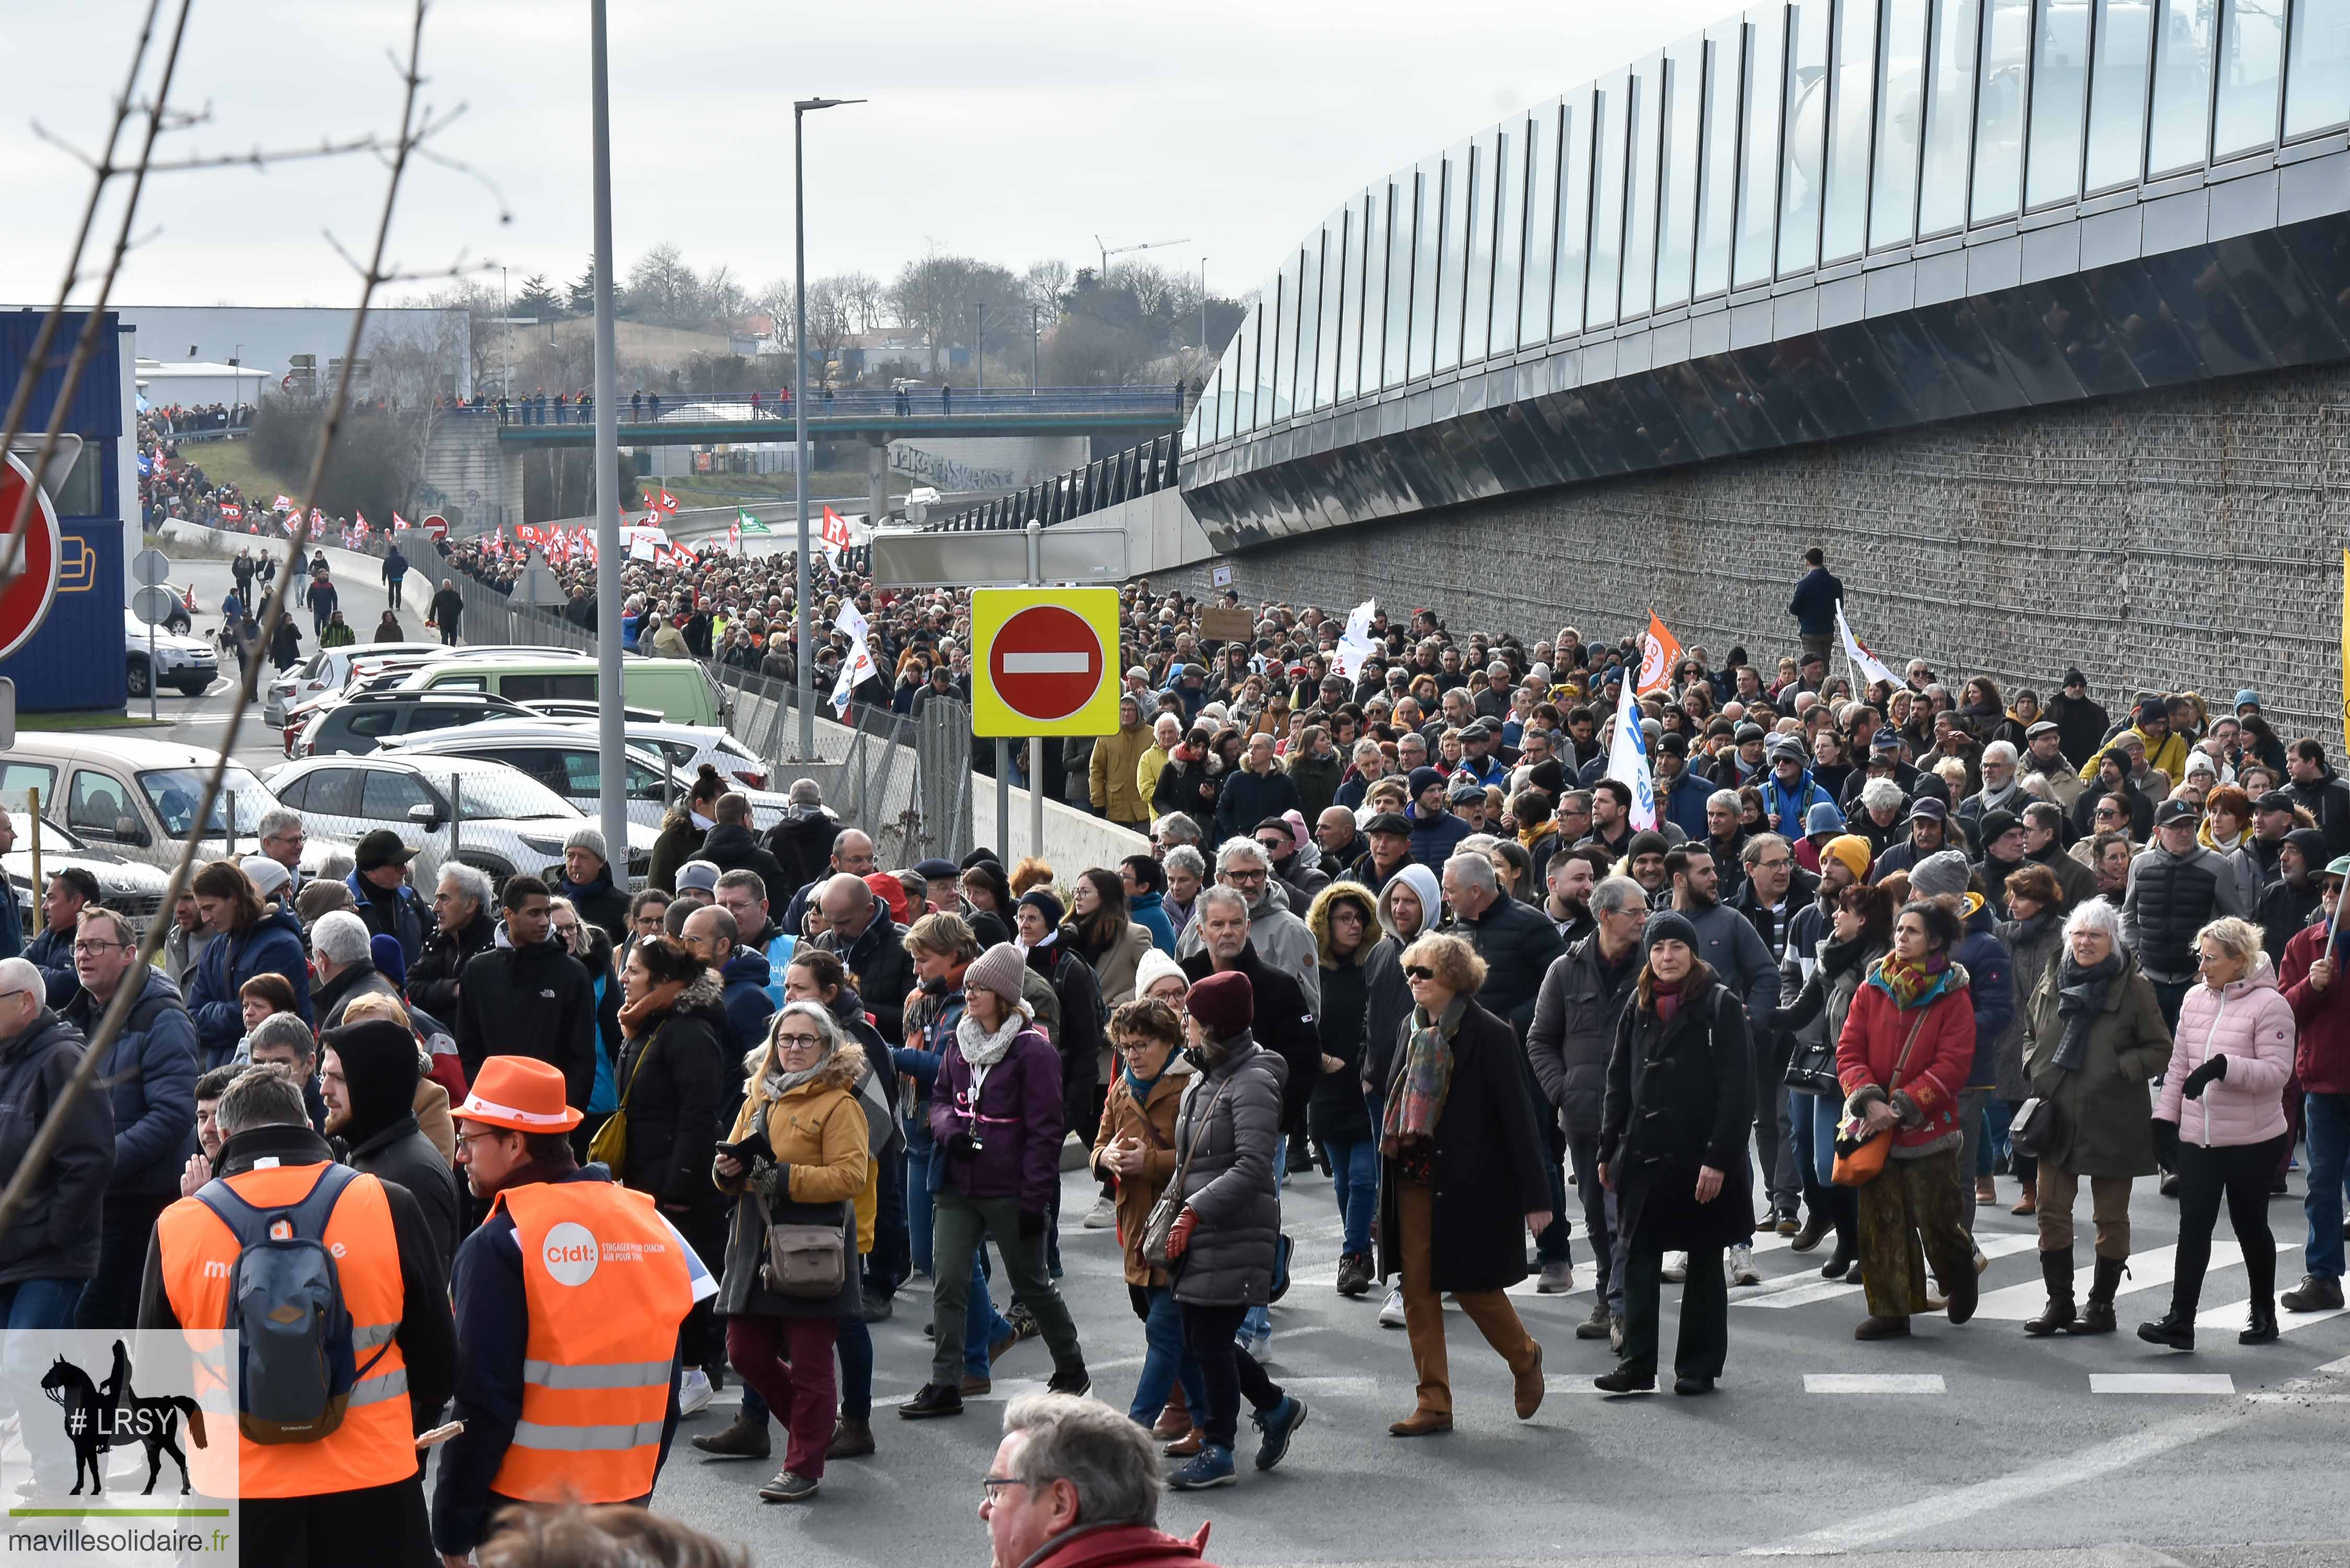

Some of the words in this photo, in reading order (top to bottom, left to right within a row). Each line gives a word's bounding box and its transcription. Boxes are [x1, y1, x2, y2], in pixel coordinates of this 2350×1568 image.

[222, 507, 239, 516] FO
[522, 526, 534, 537] FO
[673, 547, 694, 568] FO
[615, 1253, 631, 1262] POUR
